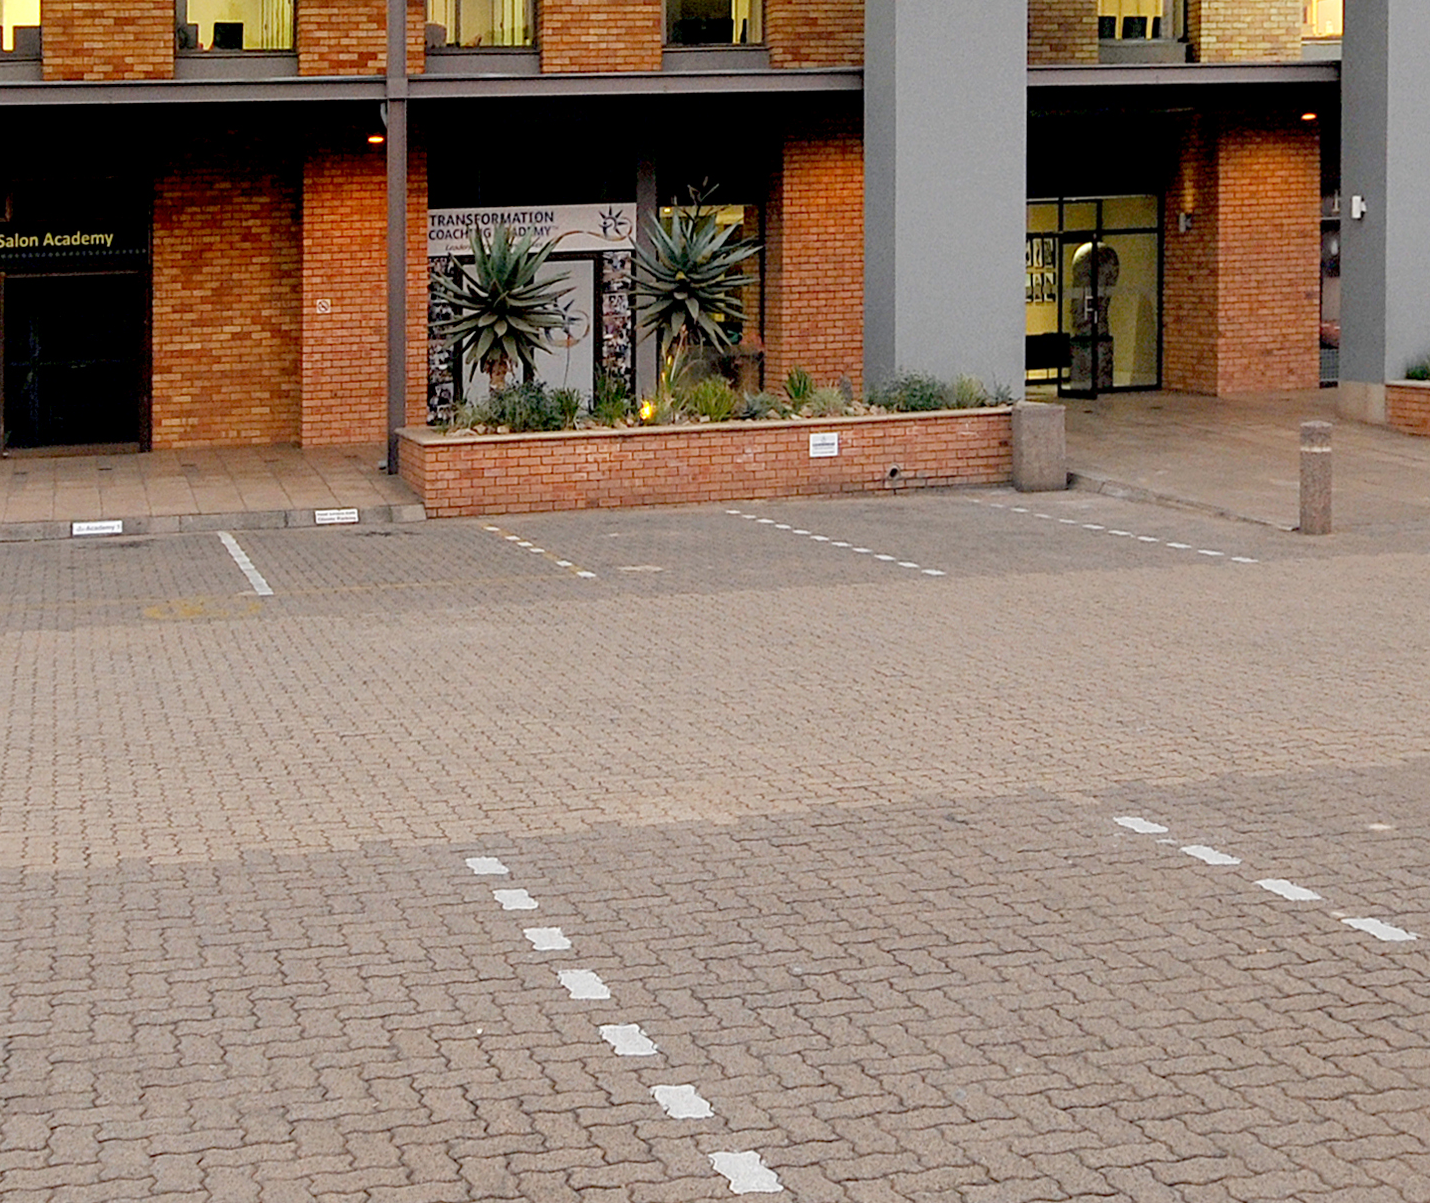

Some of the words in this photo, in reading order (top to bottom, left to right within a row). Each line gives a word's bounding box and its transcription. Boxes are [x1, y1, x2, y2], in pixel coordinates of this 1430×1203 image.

[429, 211, 554, 227] TRANSFORMATION
[42, 231, 114, 247] Academy
[428, 227, 492, 240] COACHG
